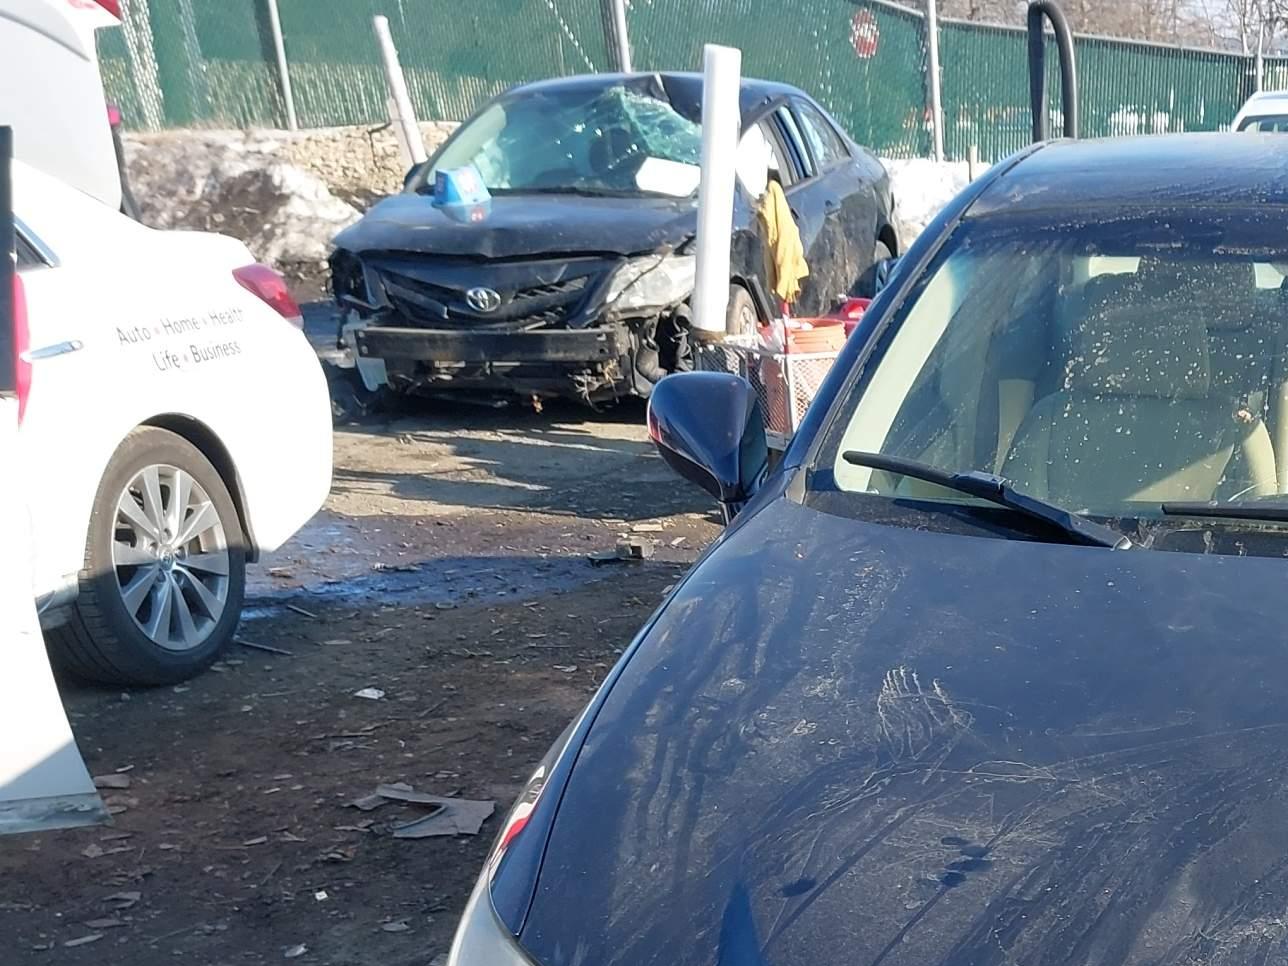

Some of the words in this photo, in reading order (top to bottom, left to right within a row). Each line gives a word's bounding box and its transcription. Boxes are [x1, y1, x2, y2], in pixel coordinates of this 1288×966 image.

[116, 326, 152, 345] Auto
[160, 318, 201, 336] Home
[152, 349, 181, 371] Life
[189, 341, 242, 363] Business
